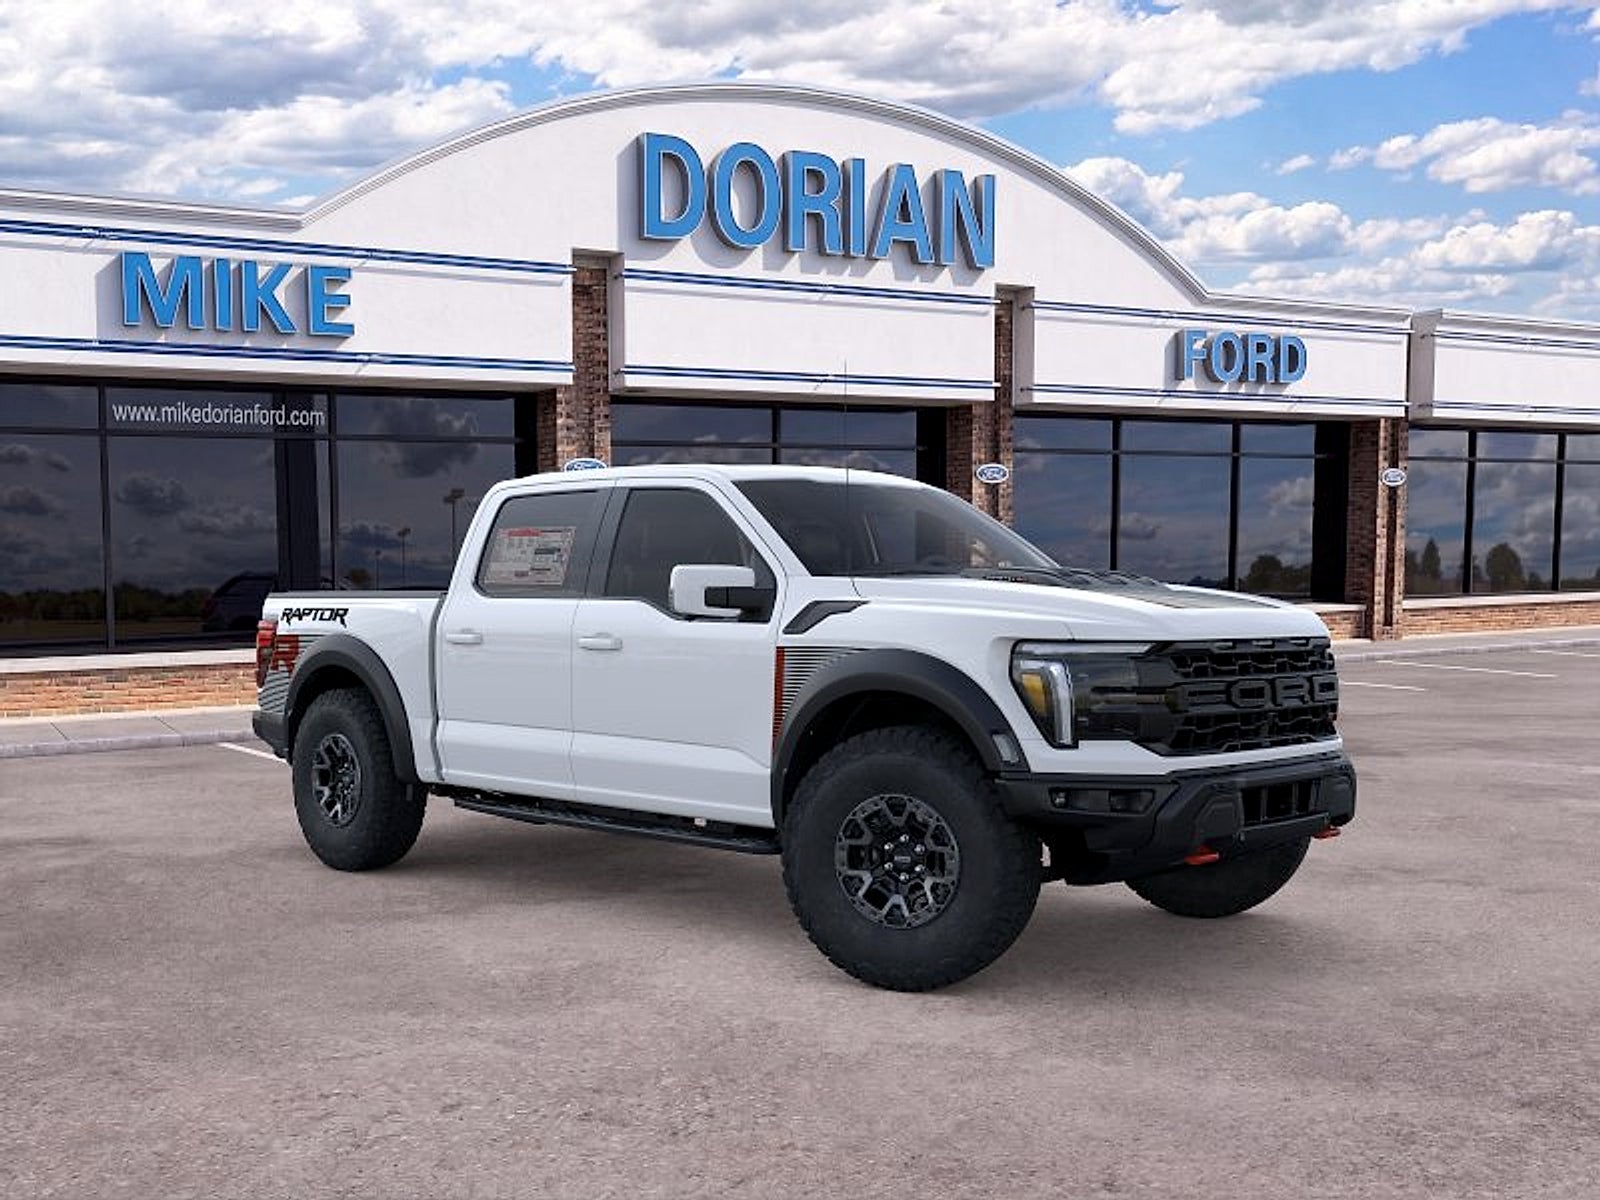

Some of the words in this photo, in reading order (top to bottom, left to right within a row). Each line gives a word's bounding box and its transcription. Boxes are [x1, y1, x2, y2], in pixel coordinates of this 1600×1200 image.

[638, 132, 996, 270] DORIAN
[121, 251, 355, 338] MIKE
[1176, 328, 1308, 383] FORD
[112, 402, 325, 426] www.mikedorianford.com
[280, 608, 349, 628] RAPTOR
[1183, 676, 1338, 711] FORD
